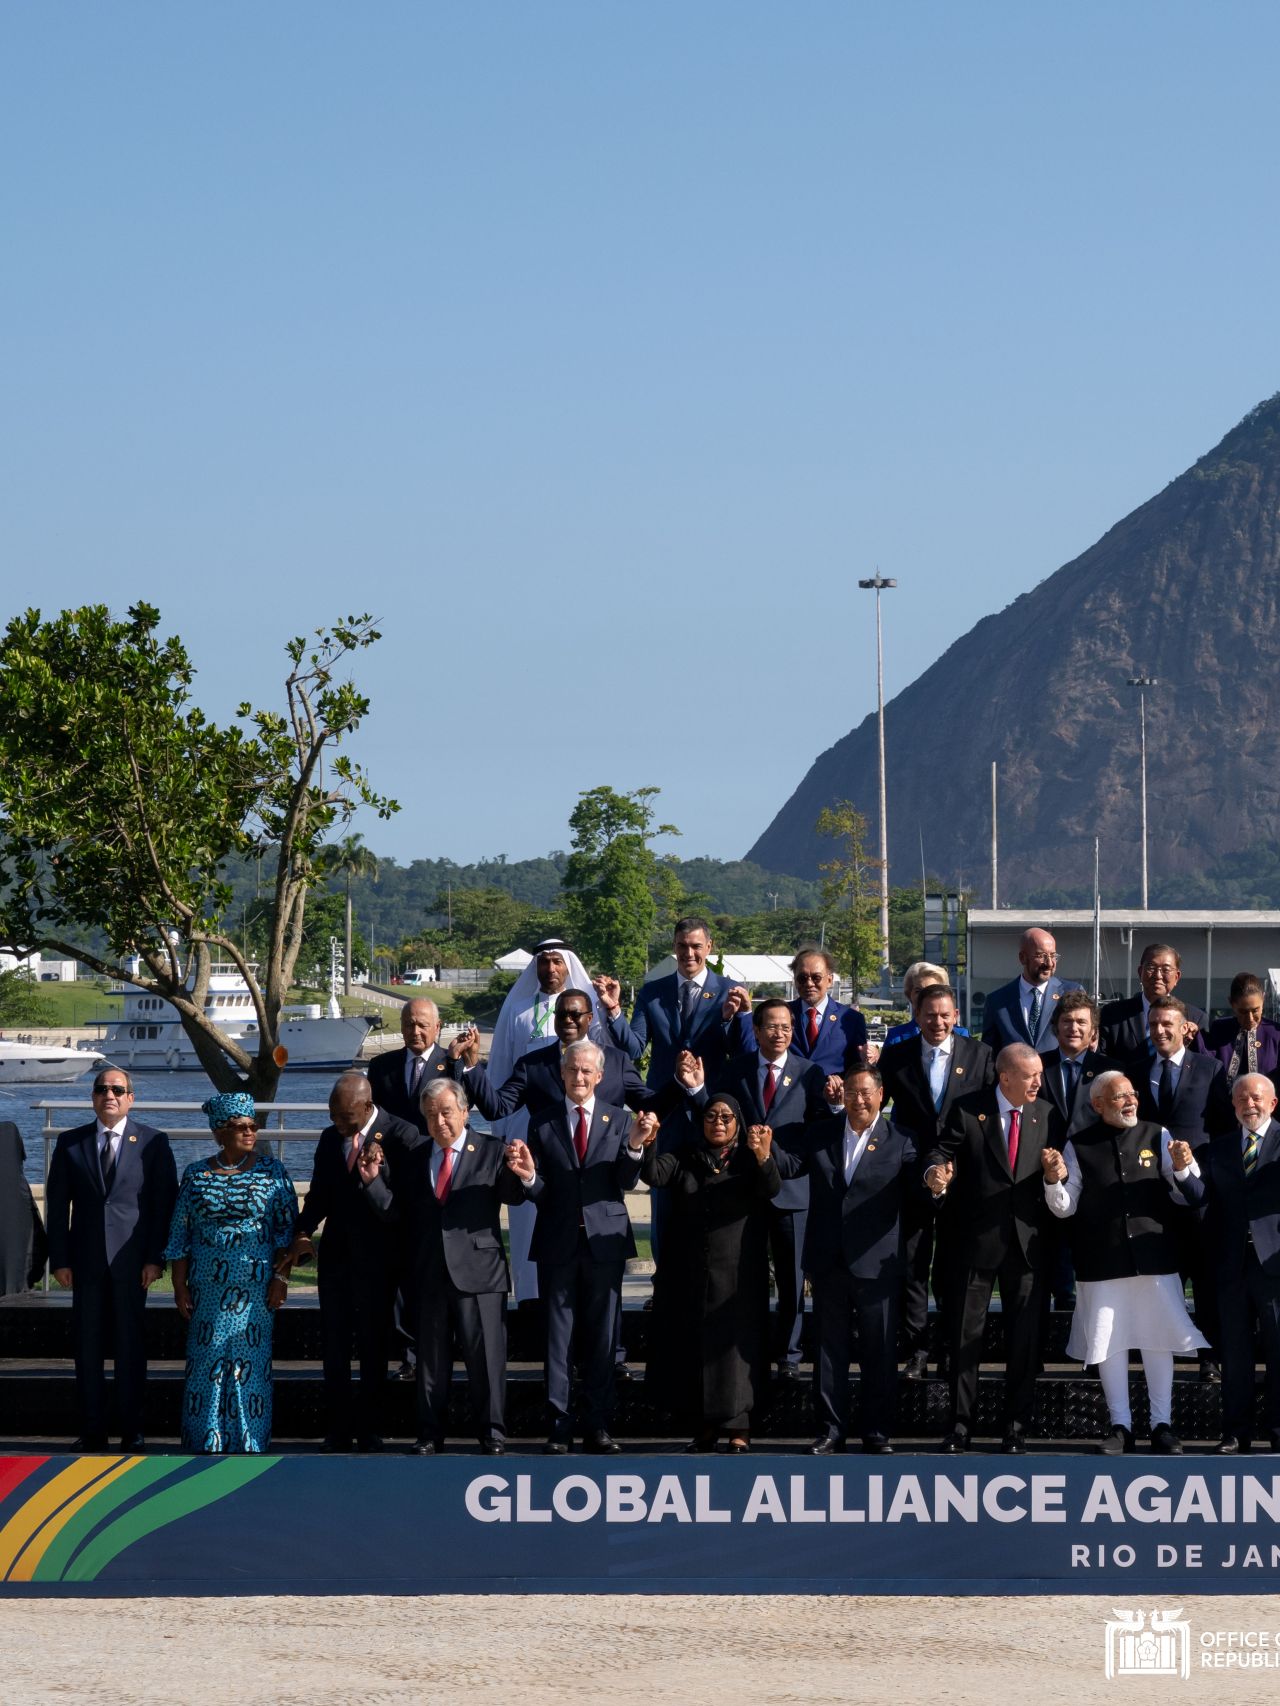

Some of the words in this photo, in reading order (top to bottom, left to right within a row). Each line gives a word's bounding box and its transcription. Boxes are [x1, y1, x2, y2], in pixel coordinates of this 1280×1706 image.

[464, 1474, 732, 1523] GLOBAL
[742, 1474, 1067, 1523] ALLIANCE
[1071, 1544, 1136, 1568] RIO
[1157, 1544, 1203, 1568] DE
